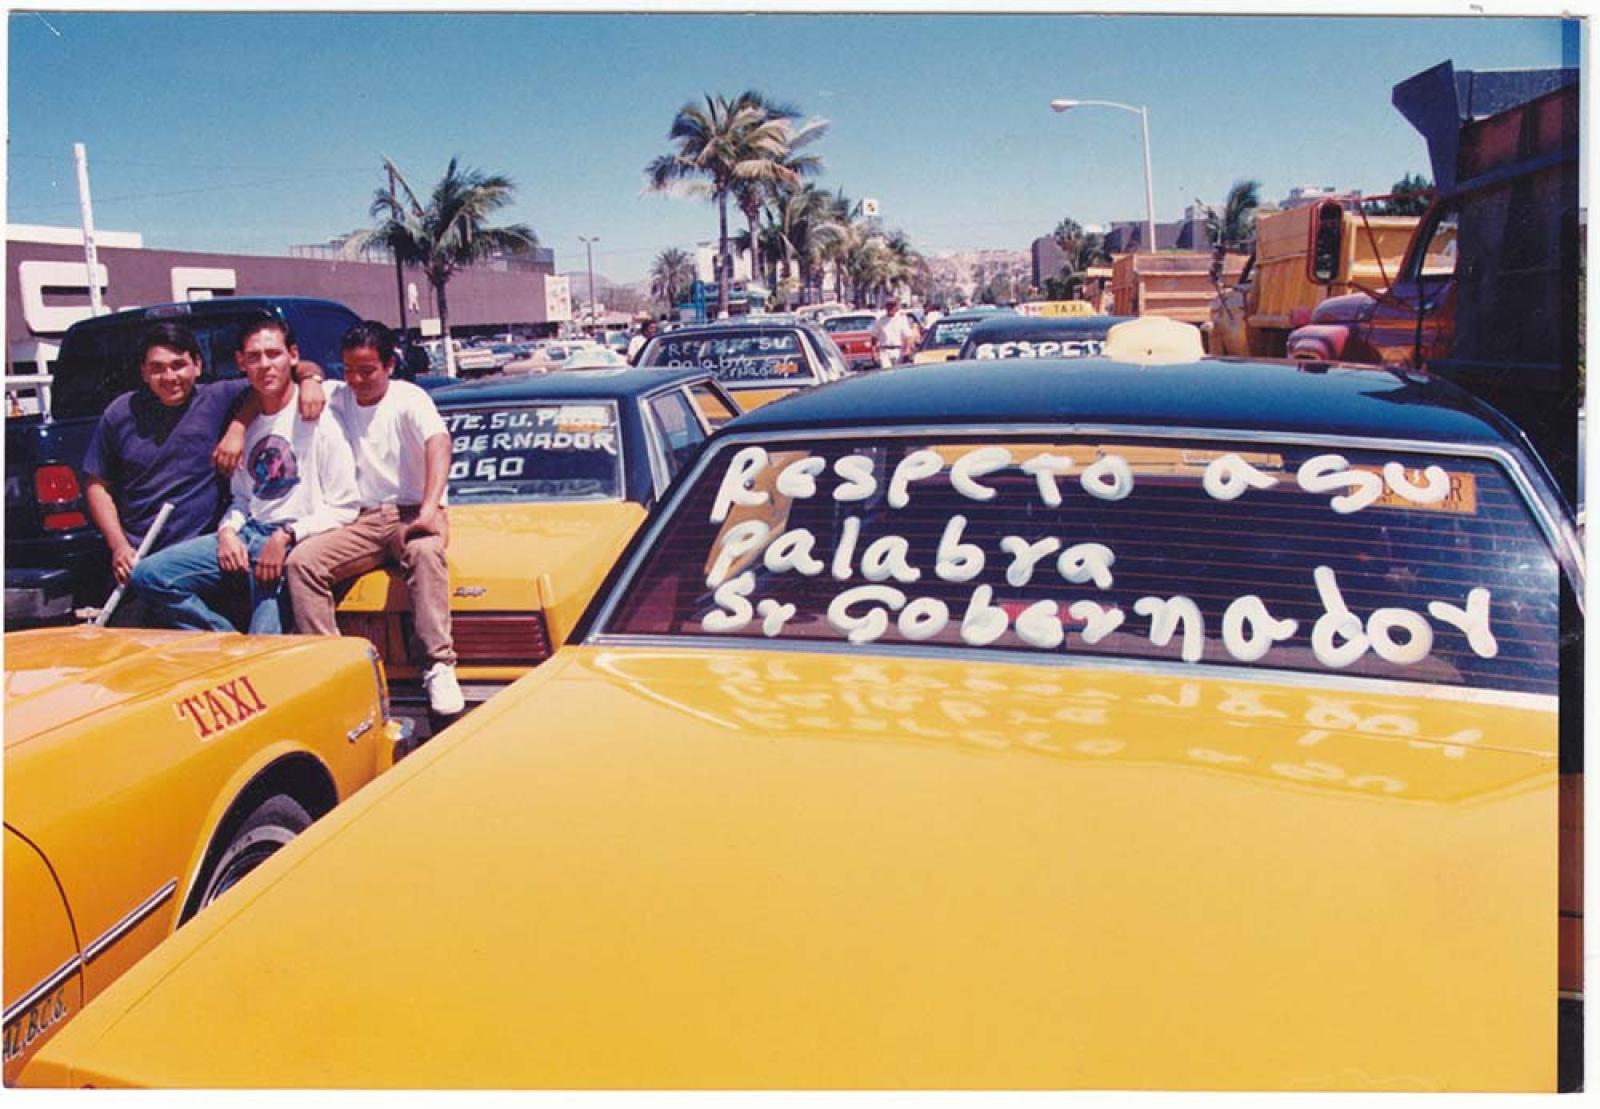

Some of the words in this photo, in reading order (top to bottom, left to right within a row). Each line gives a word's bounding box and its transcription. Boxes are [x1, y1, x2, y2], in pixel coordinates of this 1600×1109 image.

[1054, 303, 1086, 314] TAXI
[976, 341, 1108, 360] RESPET
[452, 431, 617, 456] BERNADOR
[177, 675, 267, 739] TAXI
